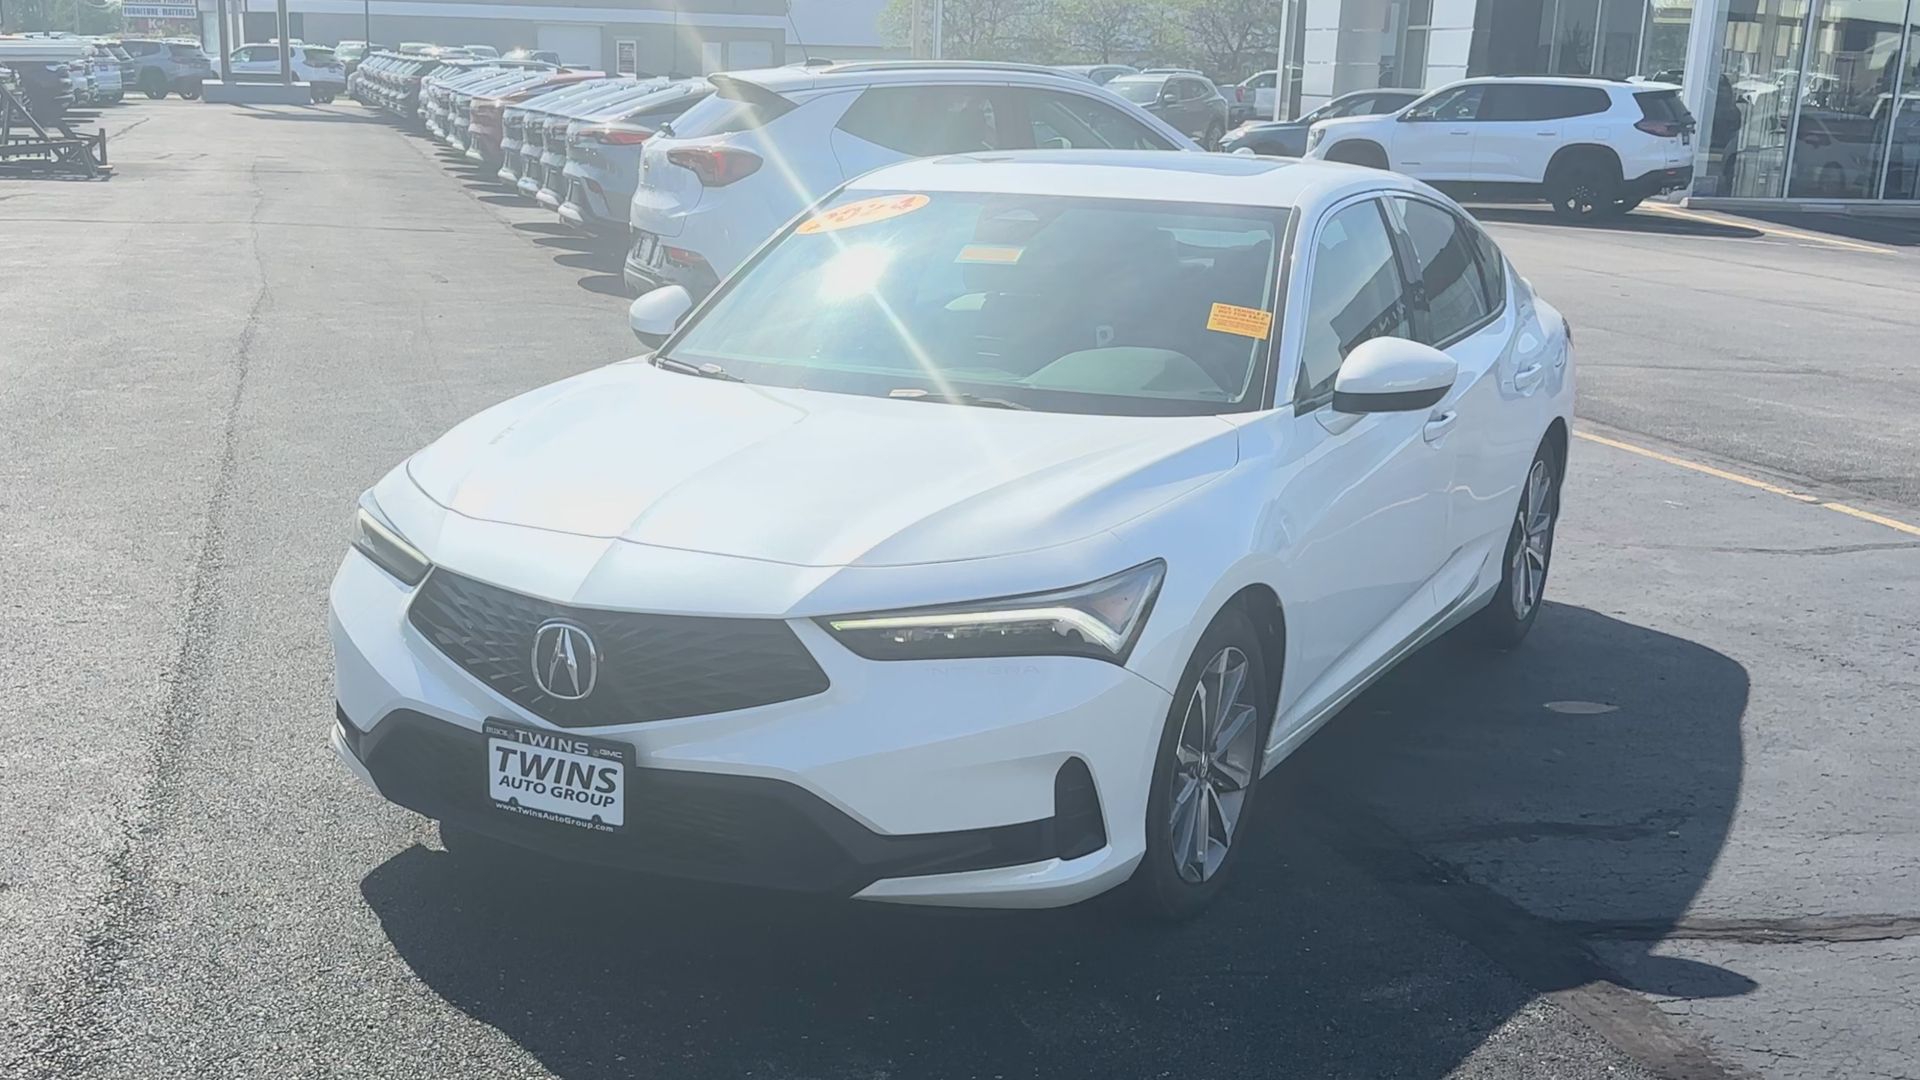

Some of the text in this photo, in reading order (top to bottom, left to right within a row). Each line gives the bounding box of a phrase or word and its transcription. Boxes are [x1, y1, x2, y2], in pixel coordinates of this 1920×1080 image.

[924, 664, 1041, 677] INTGRA
[515, 729, 589, 755] TWINS
[495, 746, 618, 794] TWINS
[499, 775, 615, 808] AUTO GROUP
[495, 802, 614, 833] www.TwinsAutoGroup.com
